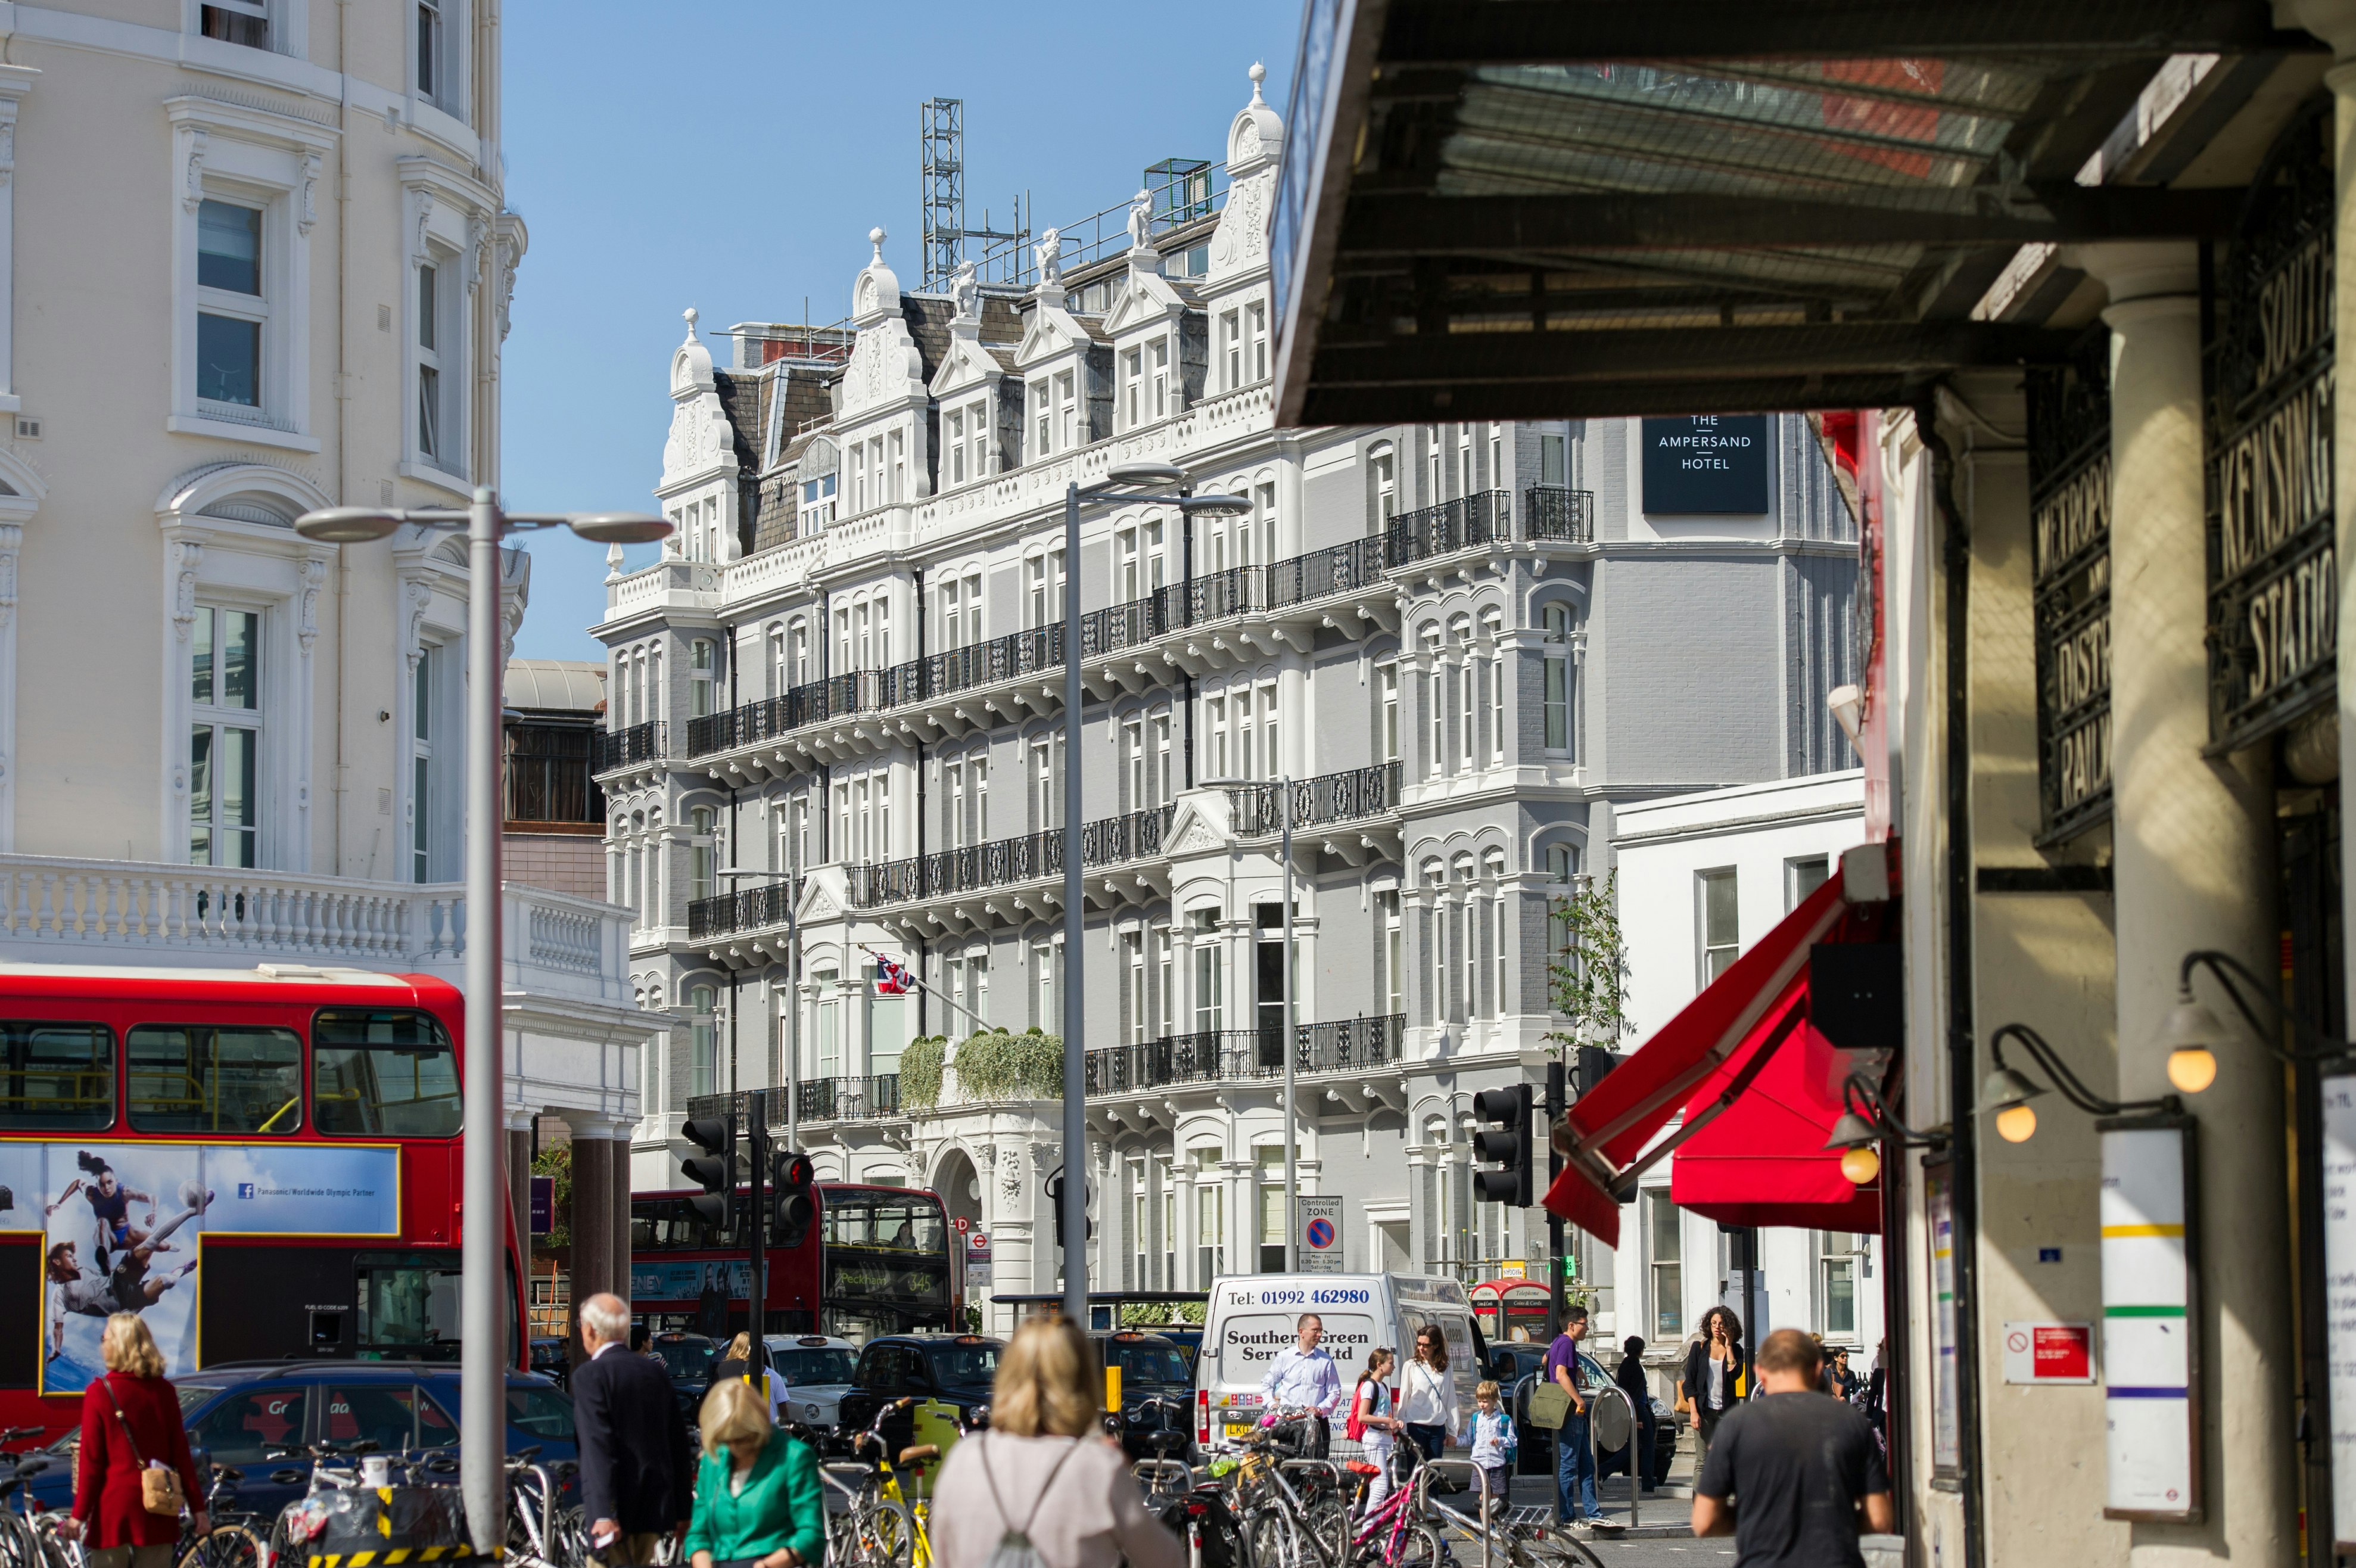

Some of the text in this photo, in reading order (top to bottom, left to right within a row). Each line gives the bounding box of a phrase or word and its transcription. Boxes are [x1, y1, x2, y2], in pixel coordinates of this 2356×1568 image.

[1691, 415, 1719, 425] THE
[1659, 437, 1751, 447] AMPERSAND
[1682, 459, 1730, 469] HOTEL
[2220, 375, 2330, 578] KENSING
[2037, 454, 2112, 579] METROPO
[2250, 547, 2336, 699] STATIO
[2059, 616, 2112, 711] DISTR
[326, 1189, 350, 1197] Olympic
[958, 1219, 967, 1230] D
[841, 1273, 930, 1292] Peckham 345
[1228, 1290, 1370, 1305] Tel: 01992 462980
[1228, 1330, 1300, 1345] Souther
[1444, 1320, 1464, 1343] Green
[1243, 1346, 1353, 1361] Serv Ltd
